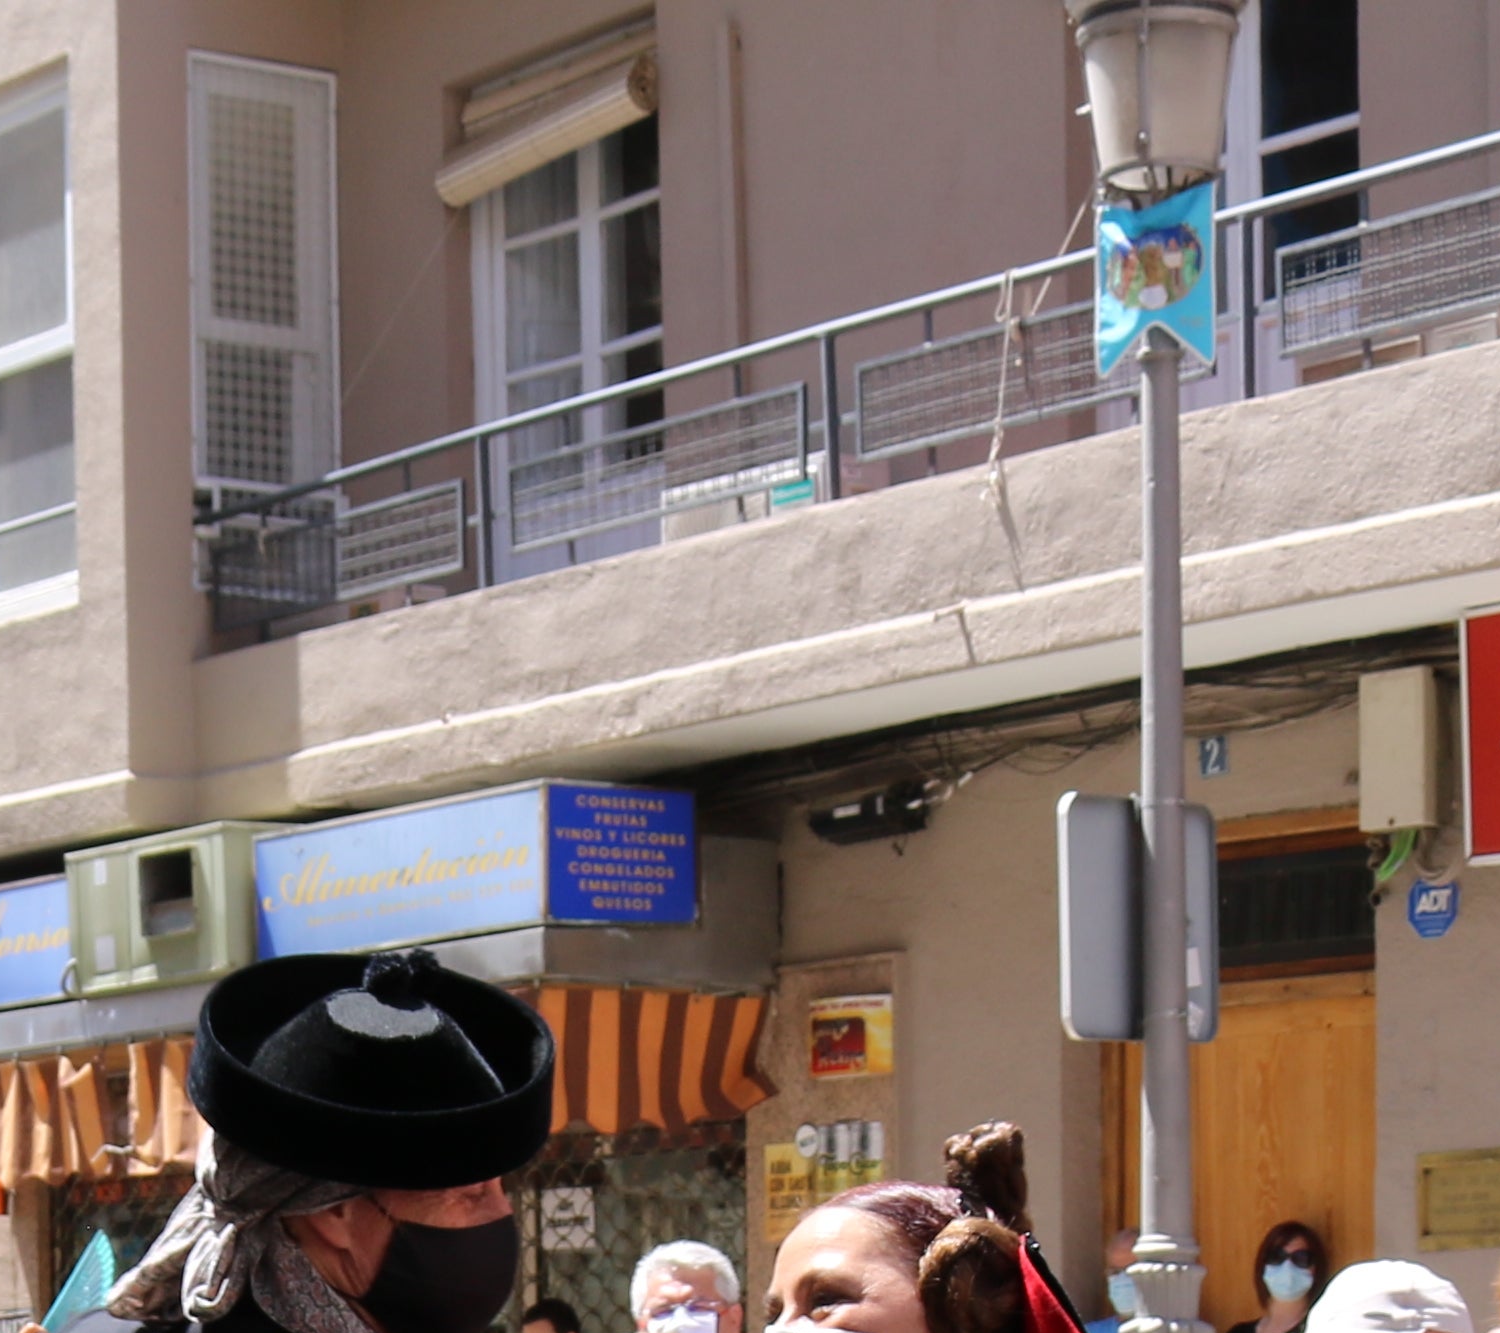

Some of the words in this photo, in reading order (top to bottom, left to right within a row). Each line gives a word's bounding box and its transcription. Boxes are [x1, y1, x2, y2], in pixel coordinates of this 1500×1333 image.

[1205, 738, 1220, 774] 2
[574, 794, 666, 812] CONSERVAS
[593, 812, 648, 828] FRUTAS
[555, 827, 603, 841] VINOS
[607, 829, 618, 842] Y
[622, 830, 687, 846] LICORES
[576, 844, 666, 862] DROGUERIA
[263, 830, 531, 912] Alimentación
[567, 860, 676, 879] CONGELADOS
[578, 877, 666, 895] EMBUTIDOS
[591, 895, 653, 911] QUESOS
[1415, 889, 1453, 915] ADT
